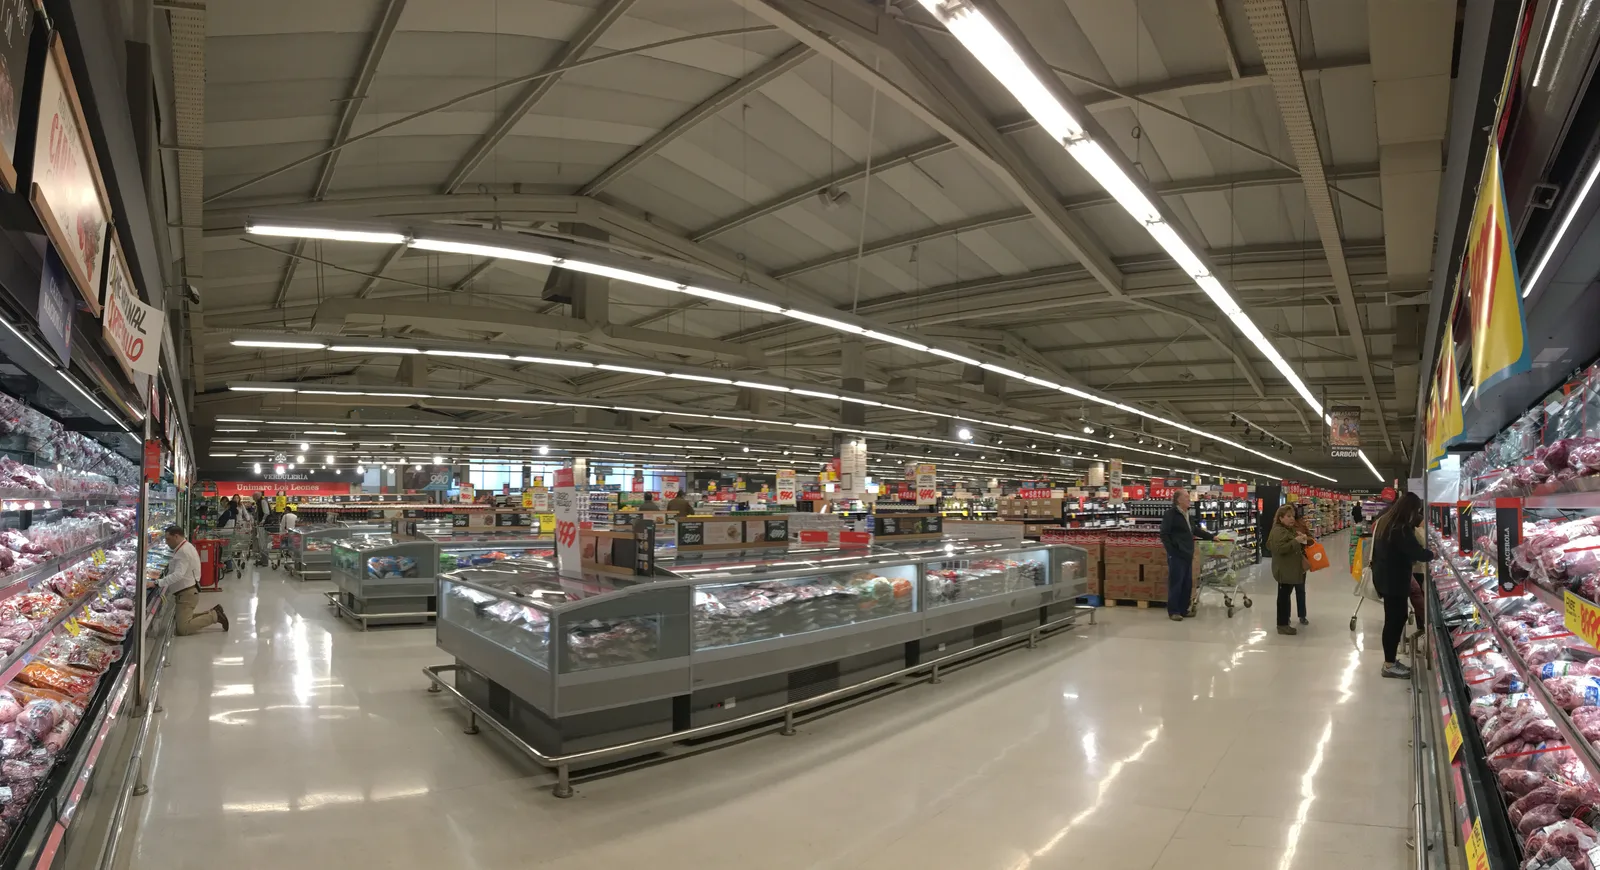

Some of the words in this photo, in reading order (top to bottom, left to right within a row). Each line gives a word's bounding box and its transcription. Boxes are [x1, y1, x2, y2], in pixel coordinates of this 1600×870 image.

[1331, 449, 1358, 457] CARBÓN
[430, 474, 449, 484] 990
[236, 483, 272, 491] Unimarc
[273, 483, 289, 491] Los
[290, 483, 320, 491] Leones
[1503, 527, 1511, 567] CACEROLA
